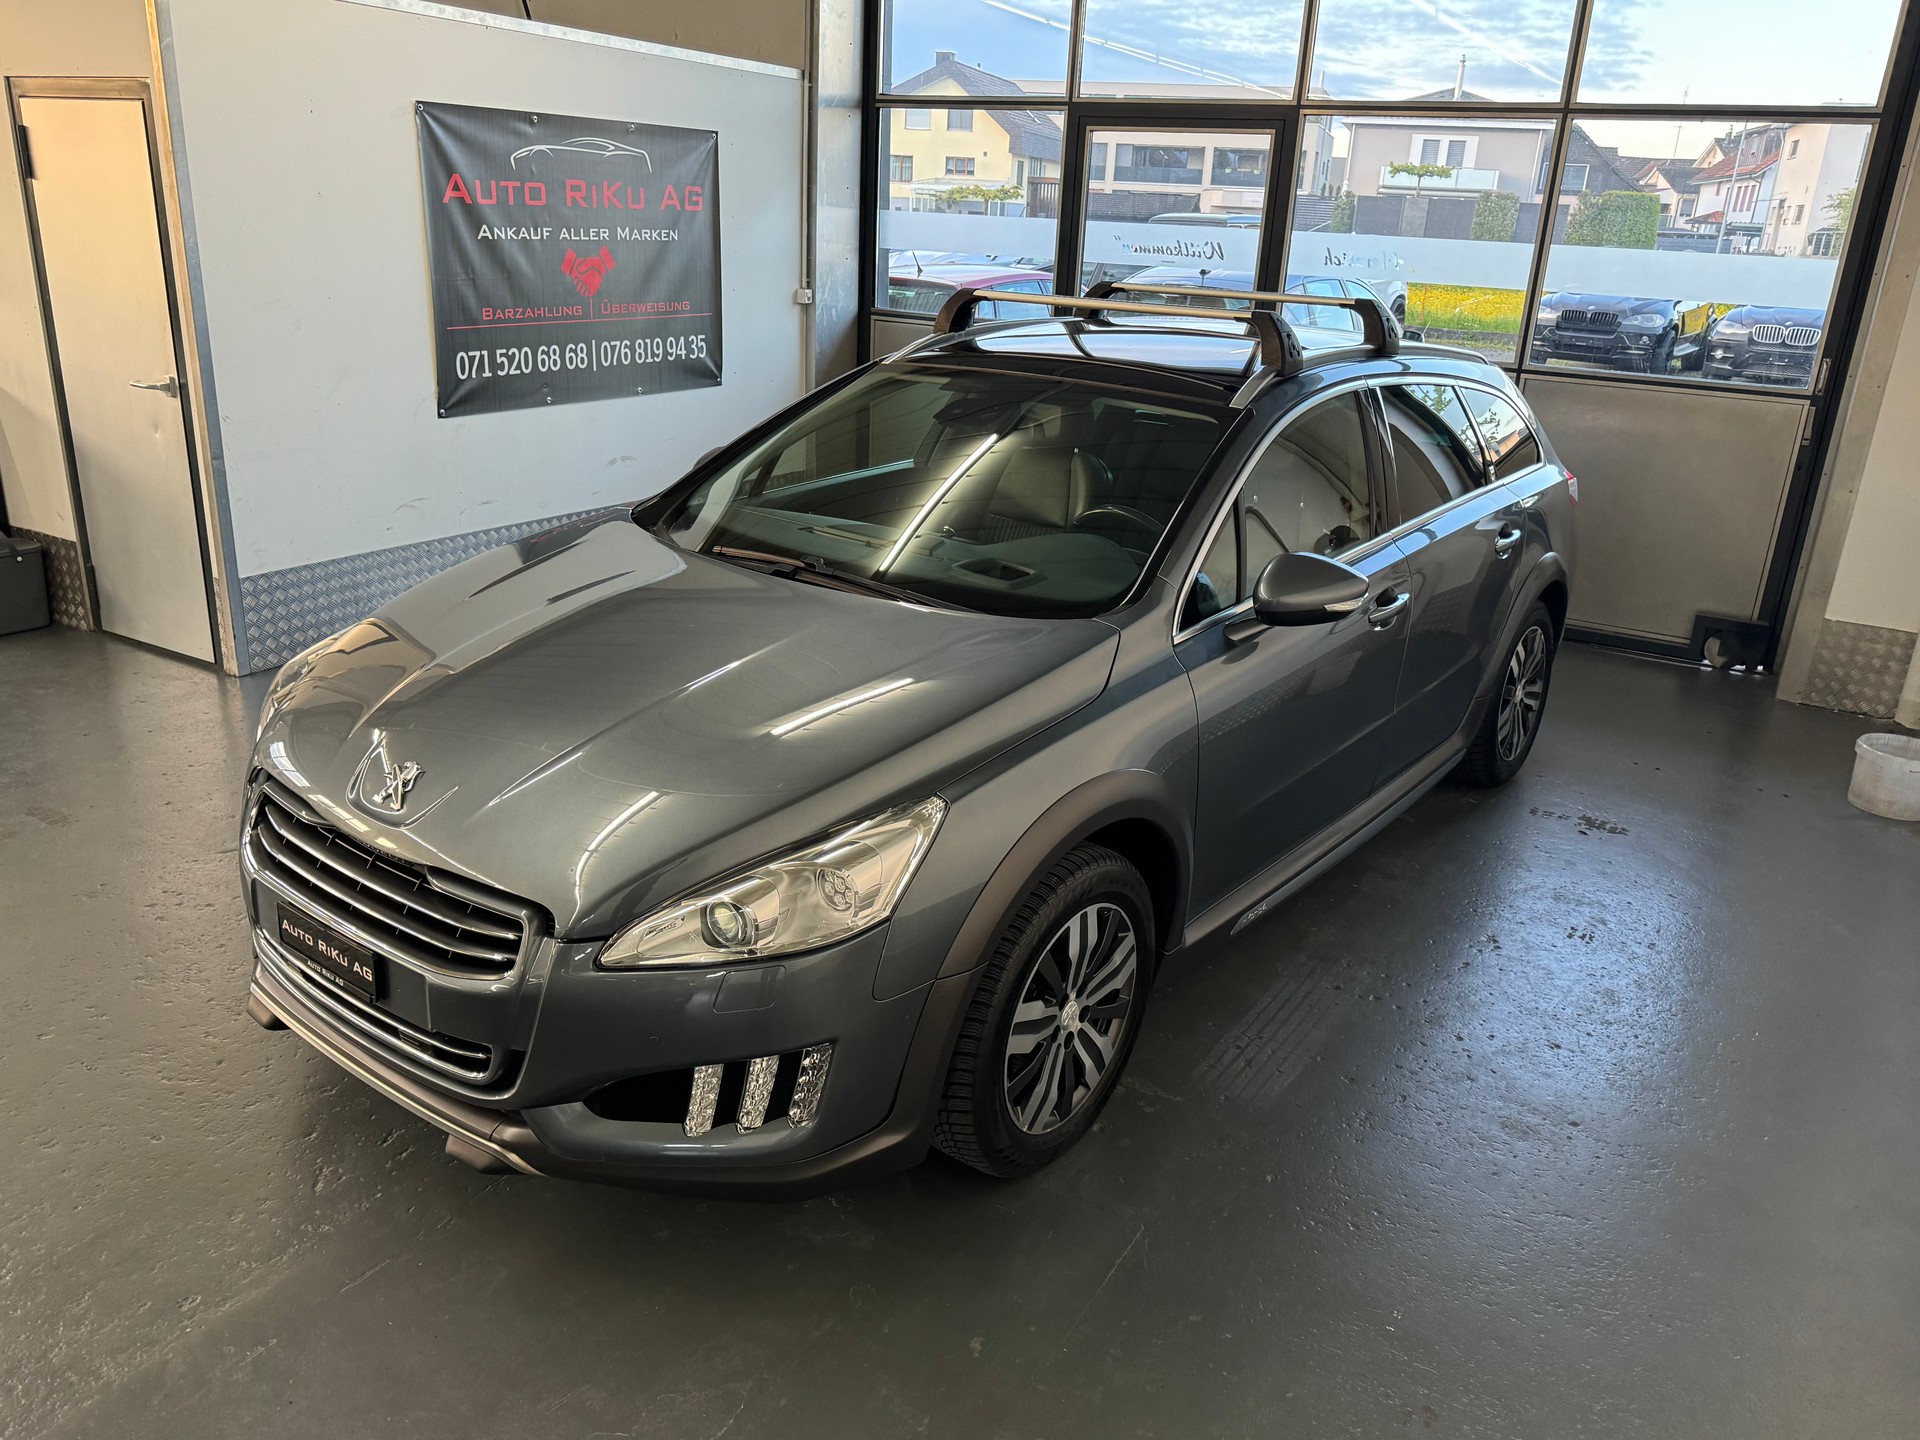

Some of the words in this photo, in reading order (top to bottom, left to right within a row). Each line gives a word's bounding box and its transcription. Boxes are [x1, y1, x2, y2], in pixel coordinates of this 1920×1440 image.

[442, 173, 547, 206] AUTO
[565, 179, 645, 210] RIKU
[659, 184, 704, 212] AG
[477, 224, 552, 240] ANKAUF
[559, 227, 610, 241] ALLER
[617, 226, 679, 241] MARKEN
[482, 303, 583, 321] BARZAHLUNG
[601, 299, 690, 314] ÜBERWEISUNG
[455, 349, 493, 380] 071
[496, 346, 533, 377] 520
[537, 344, 561, 373] 68
[565, 342, 588, 370] 68
[600, 339, 631, 367] 076
[635, 337, 662, 364] 819
[666, 336, 687, 361] 94
[688, 334, 707, 359] 35
[282, 919, 313, 946] AUTO
[318, 939, 348, 967] RIKU
[353, 961, 373, 982] AG
